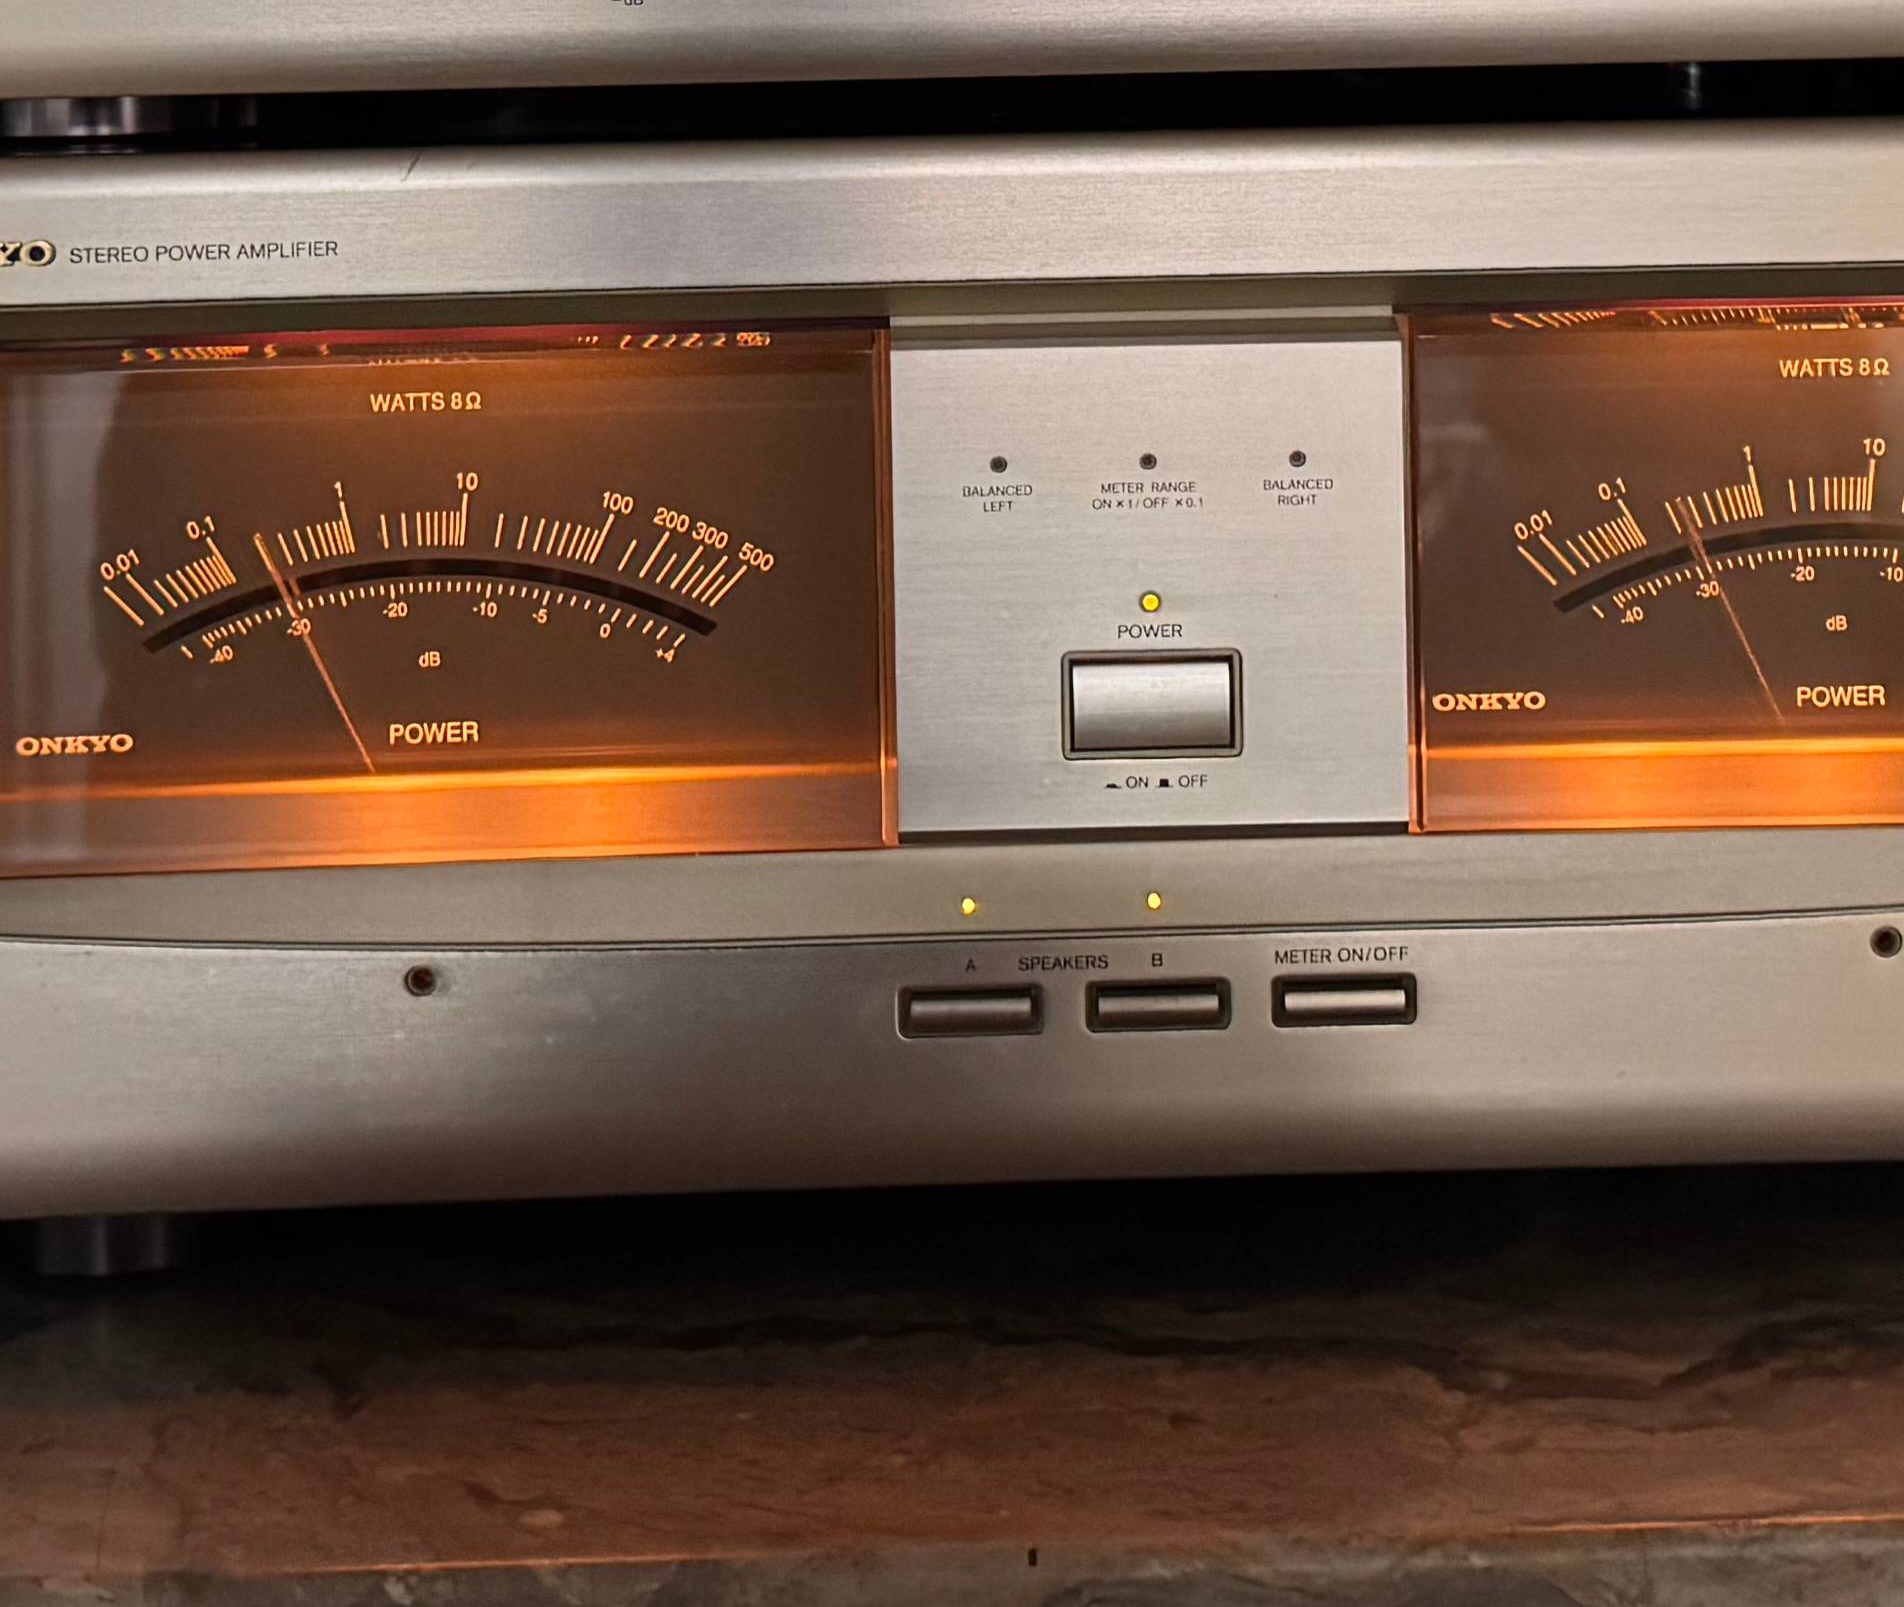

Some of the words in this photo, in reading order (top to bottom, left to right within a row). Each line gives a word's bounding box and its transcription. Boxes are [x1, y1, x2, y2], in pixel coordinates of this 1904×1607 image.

[69, 244, 149, 264] STEREO
[155, 242, 230, 262] POWER
[237, 240, 338, 260] AMPLIFIER
[1779, 359, 1853, 378] WATTS
[370, 392, 445, 412] WATTS
[962, 484, 1032, 498] BALANCED
[1101, 482, 1144, 494] METER
[1151, 481, 1196, 493] RANGE
[1263, 479, 1333, 491] BALANCED
[1514, 510, 1553, 541] 0.01
[1598, 477, 1626, 501] 0.1
[1743, 445, 1751, 462] 1
[1864, 437, 1885, 456] 10
[983, 500, 1012, 513] LEFT
[1092, 498, 1112, 510] ON
[1277, 494, 1317, 507] RIGHT
[100, 549, 140, 581] 0.01
[186, 515, 215, 540] 0.1
[334, 481, 343, 498] 1
[457, 472, 479, 491] 10
[602, 490, 634, 515] 100
[653, 506, 690, 534] 200
[692, 521, 729, 550] 300
[739, 542, 774, 572] 500
[1790, 566, 1815, 582] -20
[1879, 566, 1903, 582] -10
[383, 602, 408, 618] -20
[473, 602, 497, 618] -10
[532, 607, 548, 624] -5
[599, 623, 611, 639] 0
[656, 646, 675, 663] +4
[1117, 624, 1183, 639] POWER
[1826, 615, 1847, 631] dB
[418, 651, 441, 668] dB
[1432, 691, 1546, 711] ONKYO
[1796, 685, 1885, 707] POWER
[389, 721, 479, 745] POWER
[16, 734, 133, 756] ONKYO
[1126, 775, 1149, 789] ON
[1178, 775, 1208, 789] OFF
[965, 958, 976, 972] A
[1017, 955, 1109, 971] SPEAKERS
[1152, 953, 1163, 968] B
[1274, 949, 1332, 965] METER
[1338, 946, 1409, 964] ON/OFF
